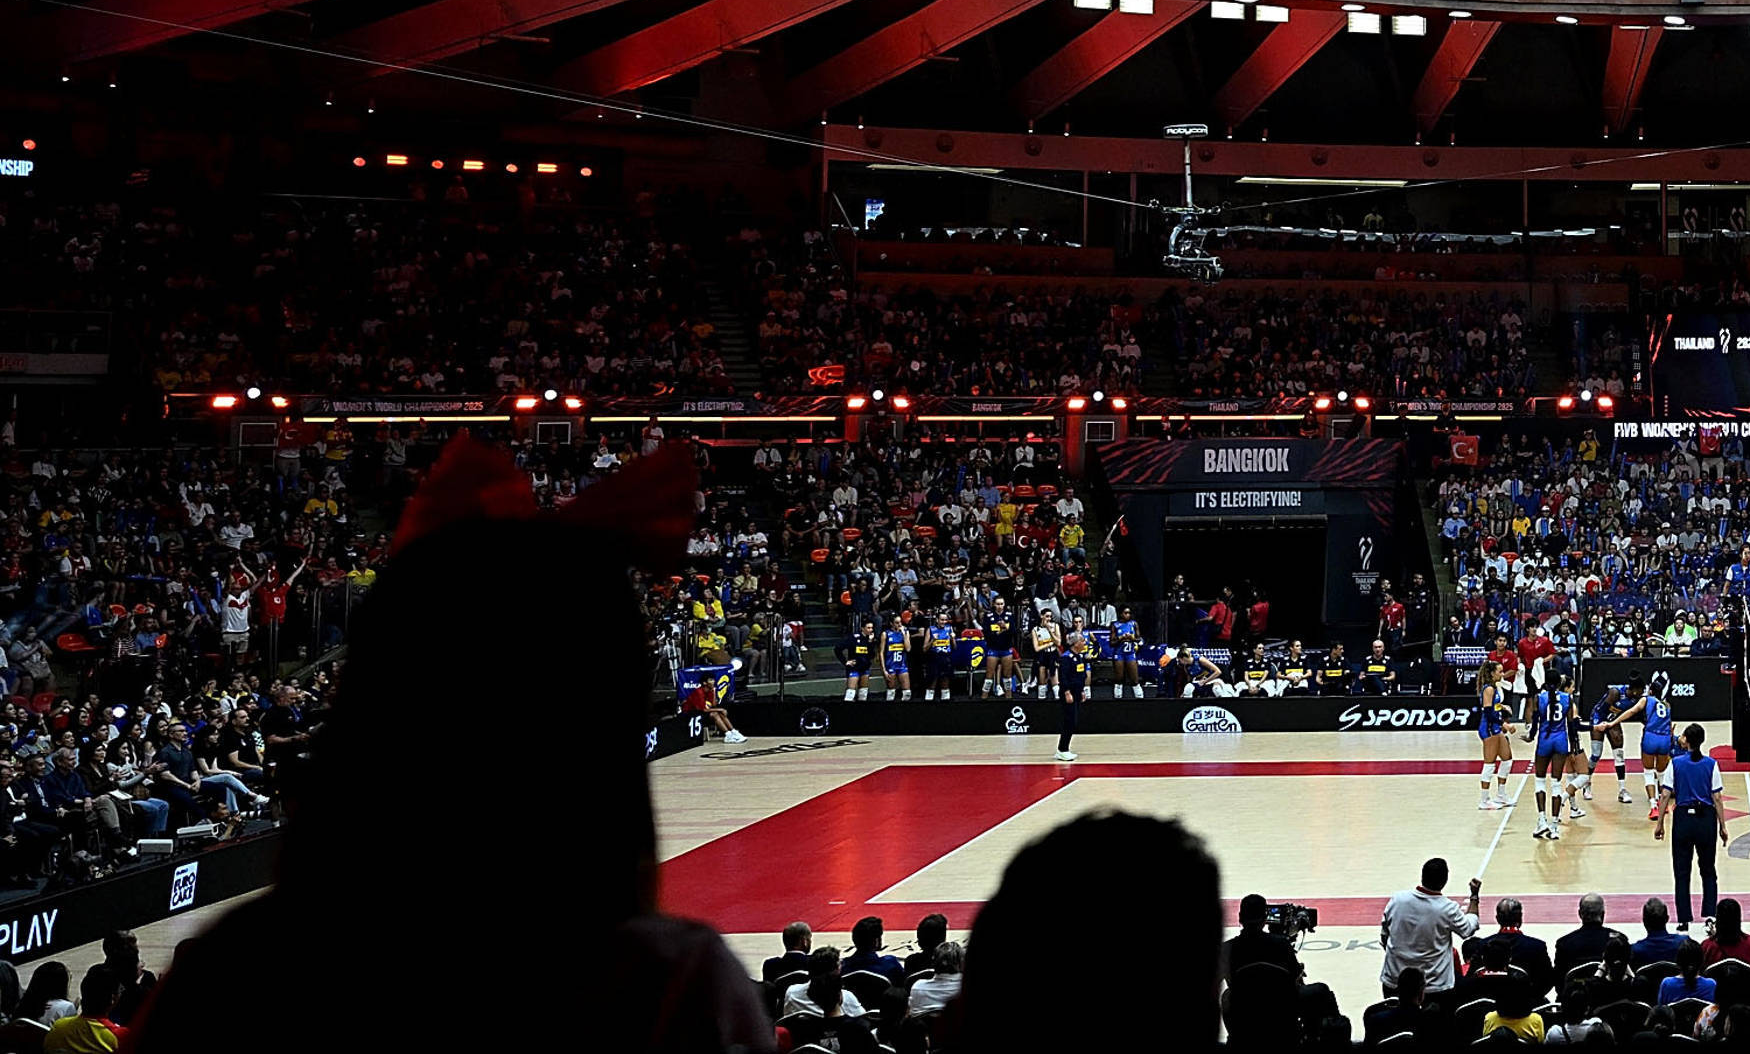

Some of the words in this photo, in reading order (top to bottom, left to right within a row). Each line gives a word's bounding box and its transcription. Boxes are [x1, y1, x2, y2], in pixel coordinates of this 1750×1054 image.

[1673, 337, 1716, 351] THAILAND
[463, 401, 484, 411] 2025
[1208, 402, 1239, 412] THAILAND
[1613, 422, 1638, 438] FIVB
[1203, 447, 1291, 474] BANGKOK
[1195, 492, 1218, 508] IT'S
[1219, 491, 1303, 508] ELECTRIFYING!
[893, 651, 903, 662] 16
[1671, 683, 1696, 697] 2025
[1361, 708, 1471, 726] SPONSOR
[1656, 702, 1667, 718] 8
[688, 715, 702, 738] 15
[0, 908, 58, 955] PLAY
